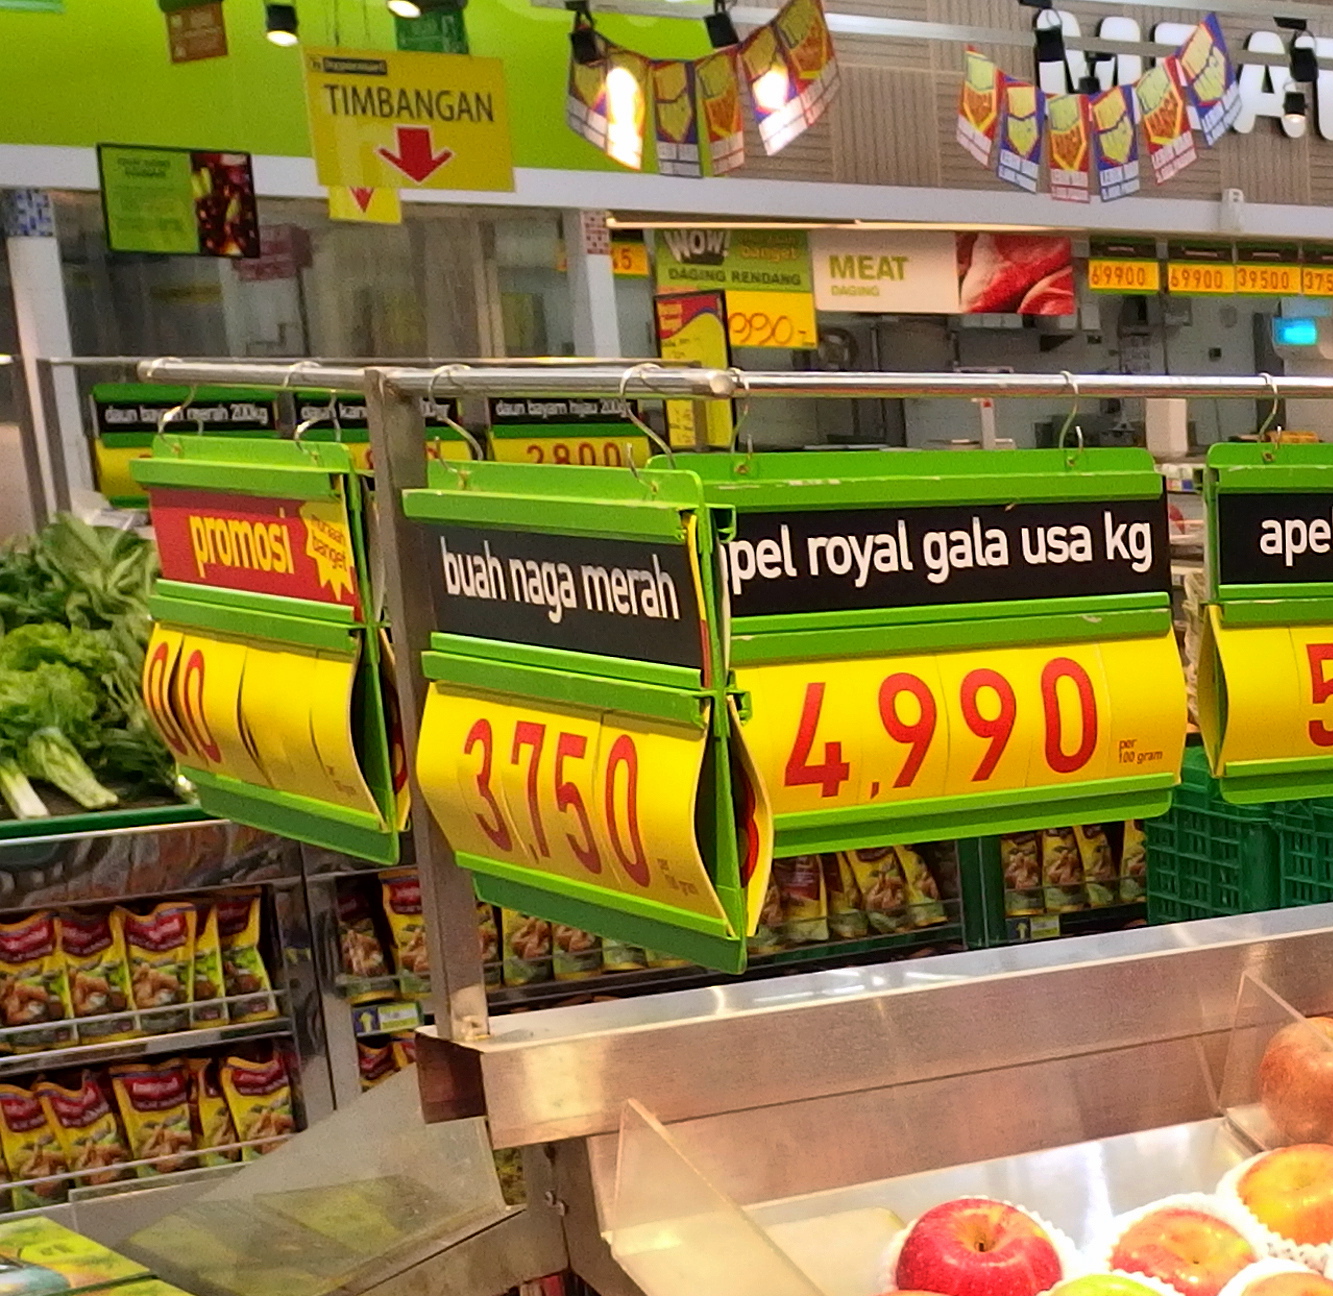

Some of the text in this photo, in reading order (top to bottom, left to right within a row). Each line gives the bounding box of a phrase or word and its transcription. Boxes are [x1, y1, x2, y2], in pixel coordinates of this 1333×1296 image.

[323, 83, 494, 123] TIMBANGAN
[663, 229, 731, 265] WOW!
[667, 266, 802, 287] DAGING RENDANG
[828, 254, 910, 282] MEAT
[1091, 267, 1146, 287] 69900
[1170, 269, 1224, 290] 69900
[1236, 269, 1290, 290] 39500
[189, 507, 296, 578] promosi
[806, 518, 914, 589] royal
[922, 515, 1010, 584] gala
[1020, 521, 1093, 565] usa
[1103, 509, 1154, 573] kg
[440, 536, 681, 625] buah naga merah
[783, 655, 1099, 801] 4,990
[1117, 736, 1138, 755] per
[1118, 747, 1164, 766] 100 gram
